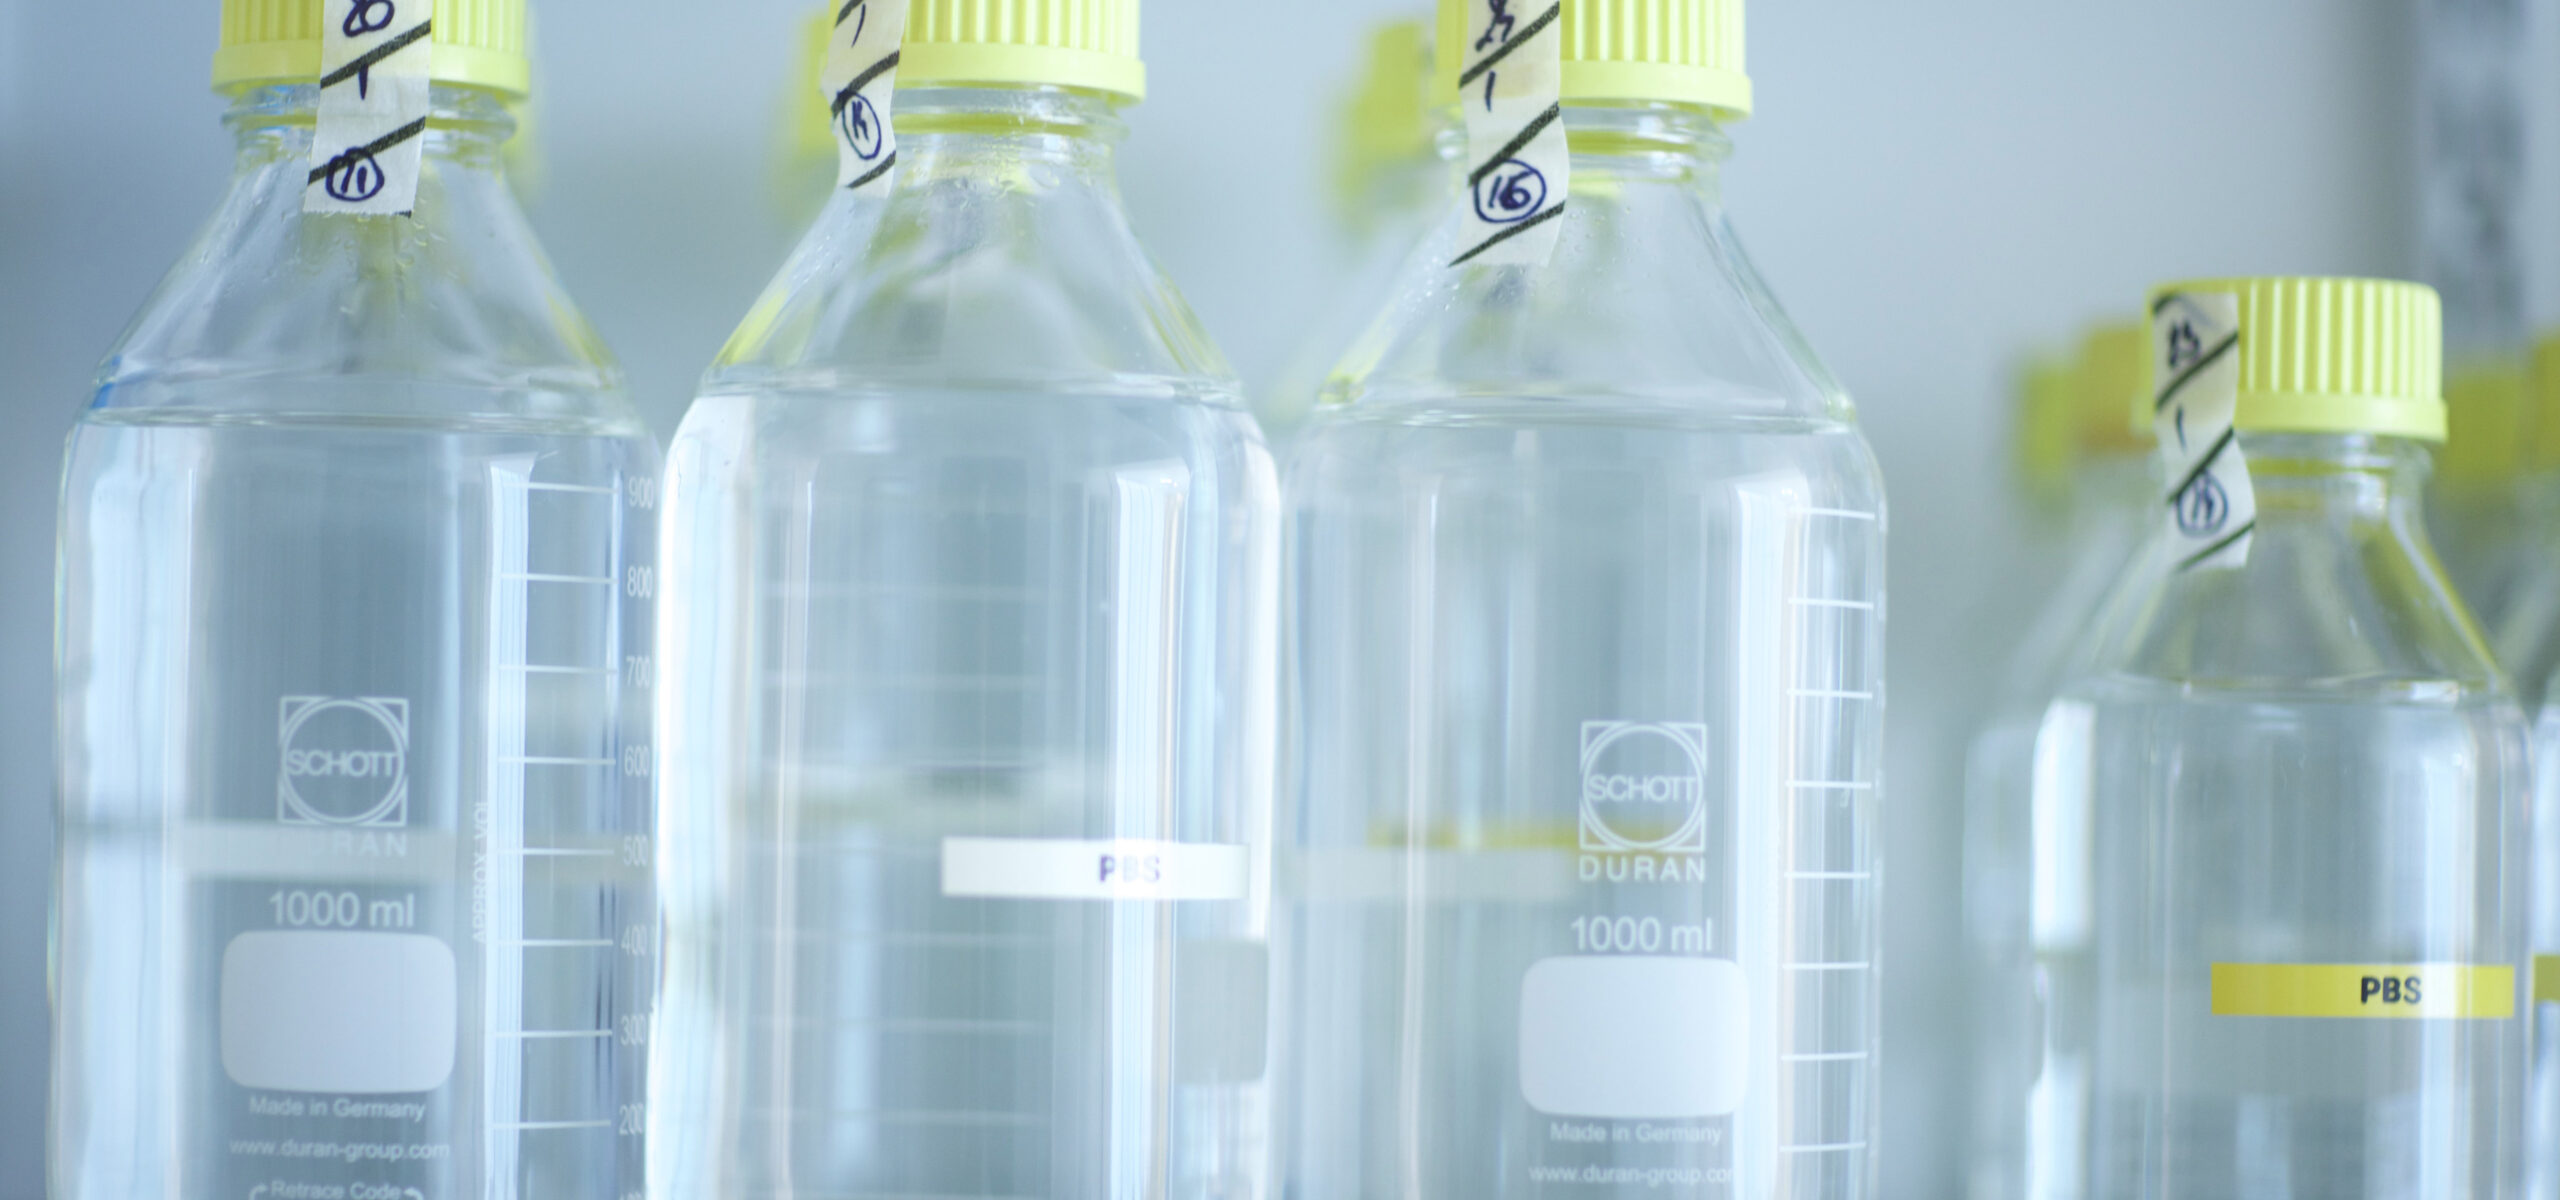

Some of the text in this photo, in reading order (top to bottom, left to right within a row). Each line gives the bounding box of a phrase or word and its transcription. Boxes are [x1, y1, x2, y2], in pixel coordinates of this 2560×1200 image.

[628, 475, 655, 510] 900
[626, 566, 653, 599] 800
[625, 656, 651, 690] 700
[286, 749, 398, 777] SCHOTT
[624, 744, 650, 778] 600
[1586, 774, 1698, 803] SCHOTT
[622, 834, 649, 867] 500
[1099, 853, 1161, 884] PBS
[1578, 855, 1707, 883] DURAN
[269, 890, 414, 928] 1000 ml
[621, 923, 648, 956] 400
[1570, 916, 1713, 952] 1000 ml
[2360, 975, 2422, 1005] PBS
[620, 1014, 647, 1046] 300
[249, 1096, 426, 1123] Made in Germany
[618, 1103, 645, 1136] 200
[229, 1139, 450, 1162] www.duran-group.com
[1550, 1122, 1723, 1147] Made in Germany
[271, 1180, 402, 1200] Retrace Code
